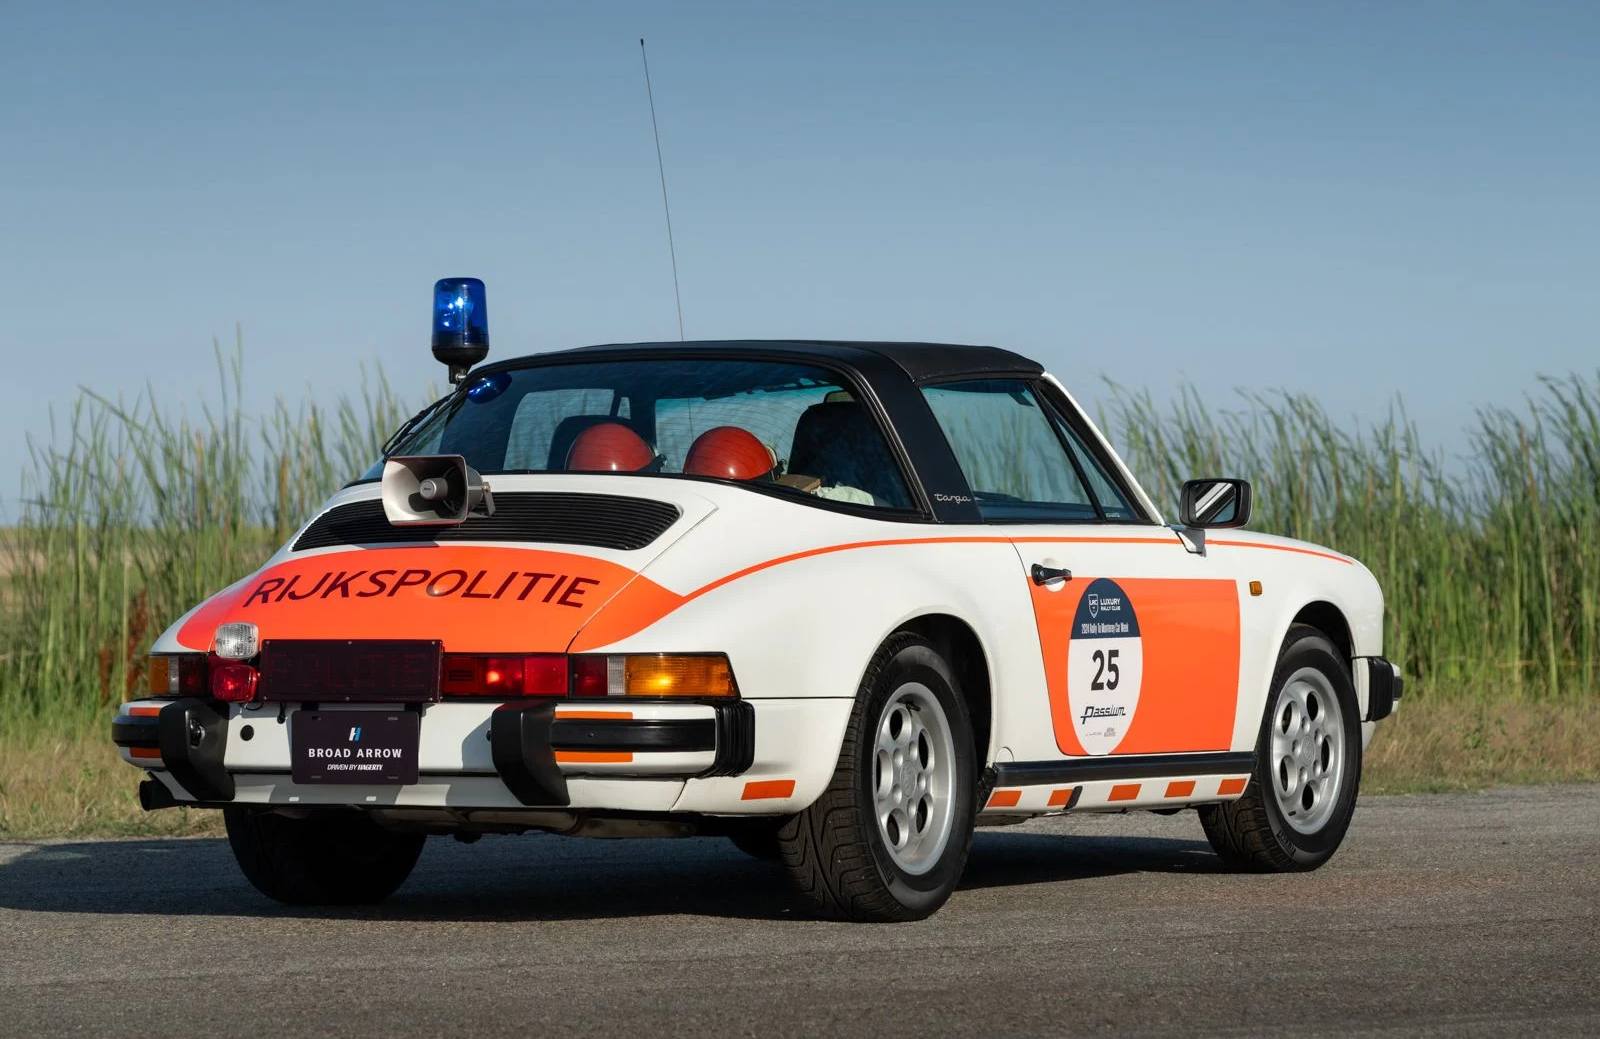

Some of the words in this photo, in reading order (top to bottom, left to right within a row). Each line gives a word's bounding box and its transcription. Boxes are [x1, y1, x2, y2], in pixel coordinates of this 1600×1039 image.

[242, 568, 601, 609] RIJKSPOLITIE
[1091, 649, 1120, 691] 25
[308, 748, 351, 758] BROAD
[356, 748, 402, 758] ARROW
[327, 763, 349, 771] DRIVEN
[349, 763, 357, 771] BY
[357, 763, 384, 771] HAGERTY
